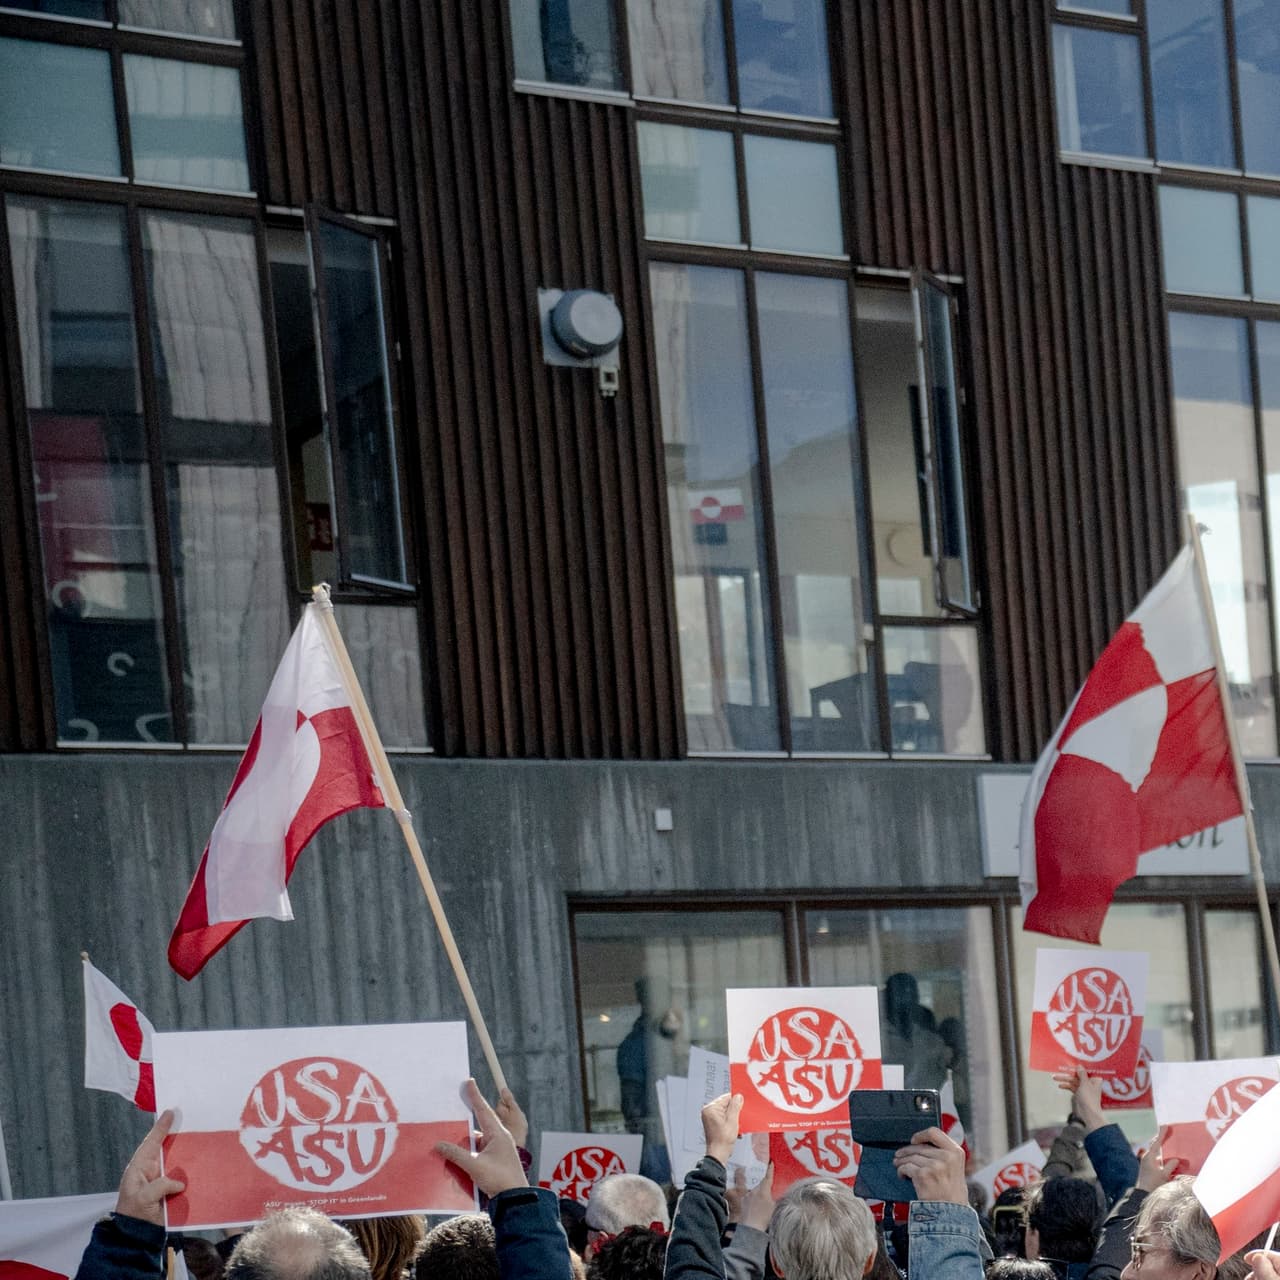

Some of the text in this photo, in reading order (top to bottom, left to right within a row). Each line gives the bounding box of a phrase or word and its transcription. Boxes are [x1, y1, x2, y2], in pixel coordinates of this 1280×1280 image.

[1058, 970, 1130, 1015] USA
[758, 1010, 856, 1062] USA
[1054, 1012, 1126, 1057] ASU
[252, 1061, 390, 1128] USA
[757, 1060, 854, 1110] ASU
[1211, 1078, 1264, 1120] US
[254, 1122, 386, 1186] ASU
